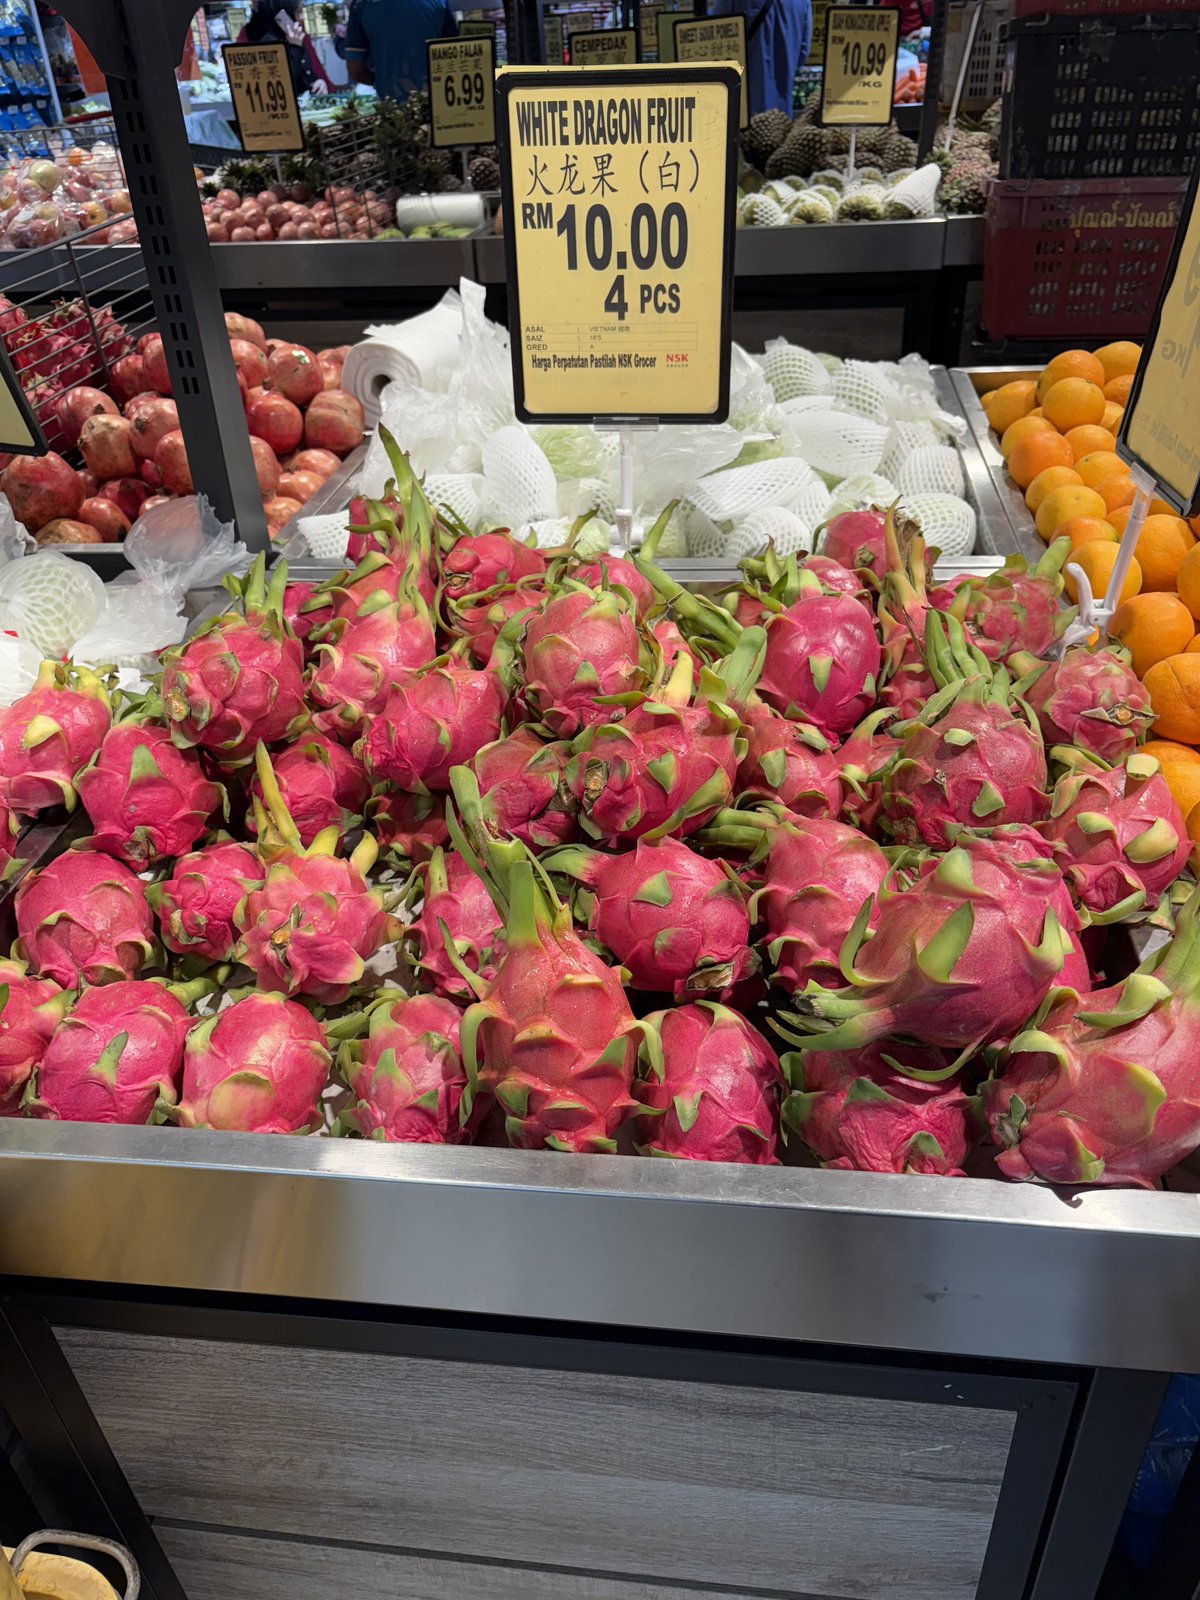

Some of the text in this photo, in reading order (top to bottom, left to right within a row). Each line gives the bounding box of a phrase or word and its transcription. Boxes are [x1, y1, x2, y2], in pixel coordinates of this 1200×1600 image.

[431, 43, 483, 60] MANGO FALAN
[575, 35, 628, 53] CEMPEDAK
[227, 50, 278, 66] PASSION FRUIT
[832, 35, 844, 45] RM
[842, 41, 886, 76] 10.99
[246, 80, 287, 113] 11.99
[445, 73, 484, 107] 6.99
[268, 112, 290, 120] /KG
[516, 96, 696, 147] WHITE DRAGON FRUIT
[526, 148, 699, 198] 火龙果（白）
[521, 202, 688, 271] RM 10.00
[604, 274, 681, 321] 4 PCS
[525, 325, 546, 333] ASAL
[589, 325, 617, 333] VIETNAM
[526, 334, 543, 342] SAIZ
[526, 343, 548, 351] GRED
[531, 353, 656, 372] Harga Perpatutan Pastilah NSK Grocer
[665, 353, 689, 362] NSK
